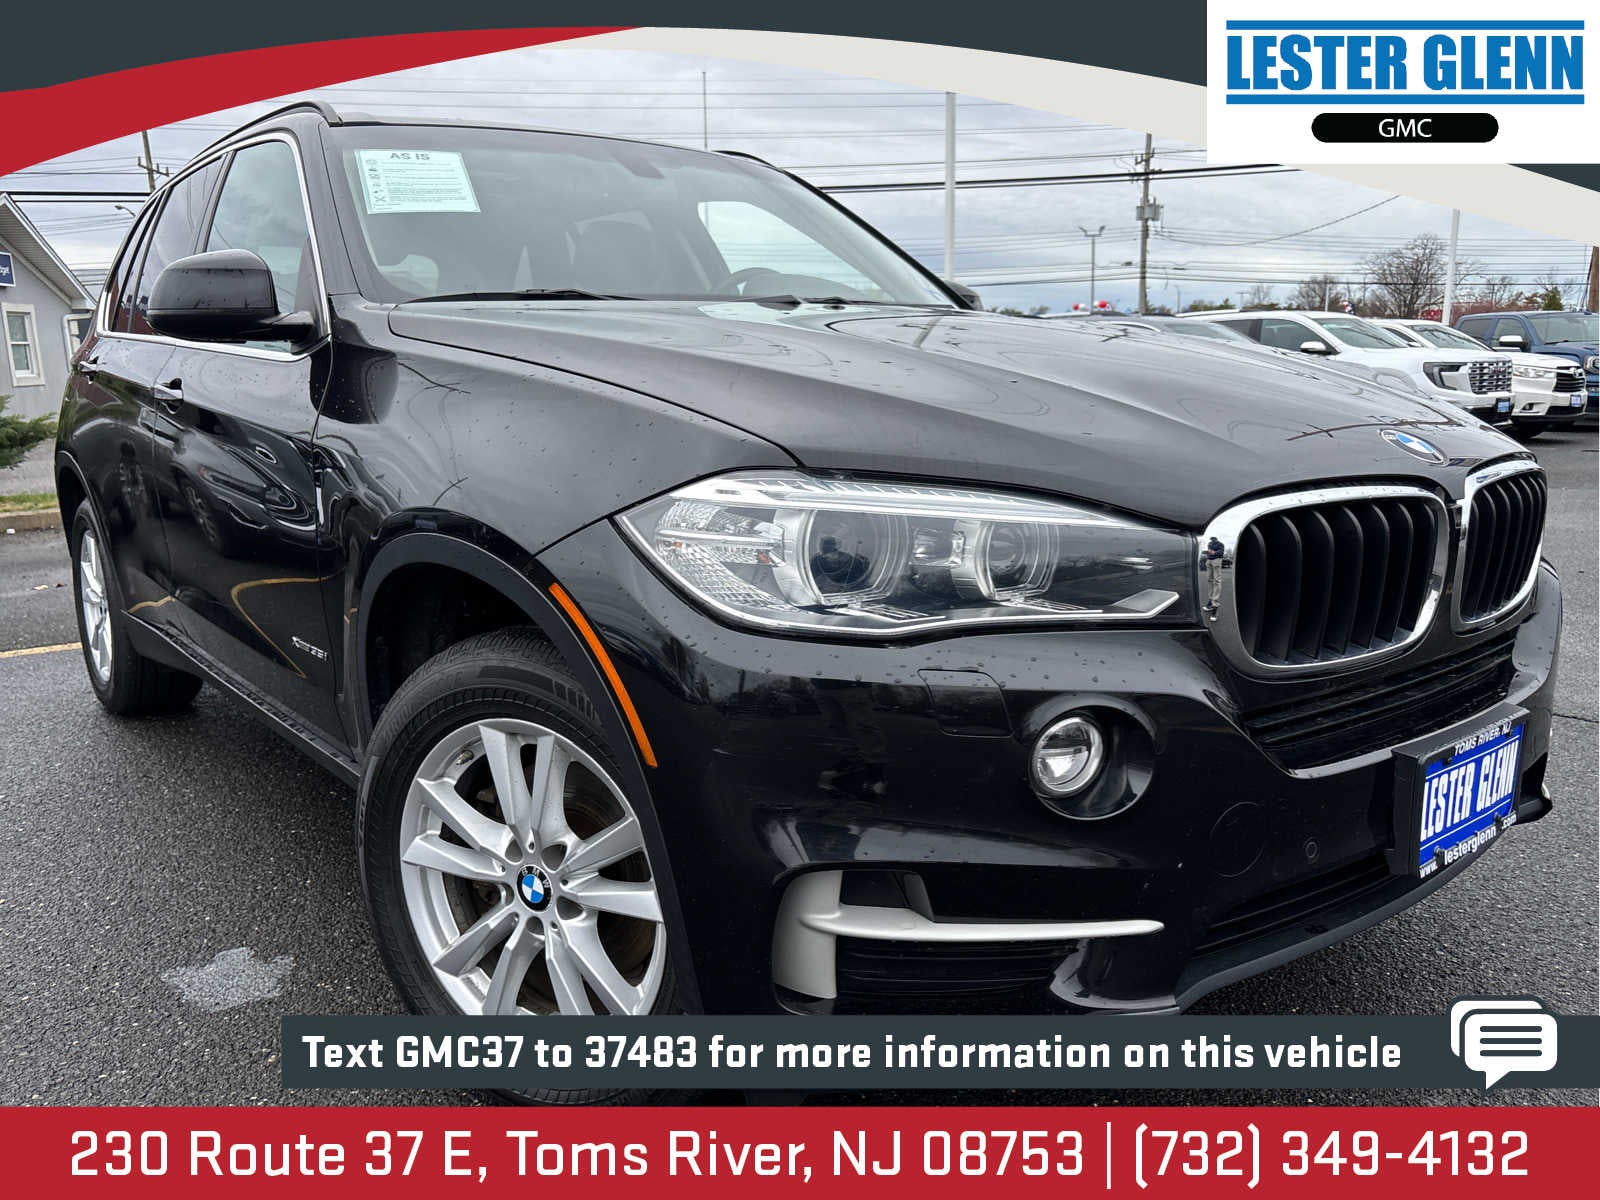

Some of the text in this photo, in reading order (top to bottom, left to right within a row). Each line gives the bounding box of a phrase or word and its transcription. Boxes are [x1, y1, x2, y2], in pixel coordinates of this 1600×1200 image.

[390, 152, 411, 160] AS
[1454, 737, 1477, 756] TOMS
[1420, 740, 1519, 843] LESTER GLENN
[1443, 825, 1497, 866] lesterglenn
